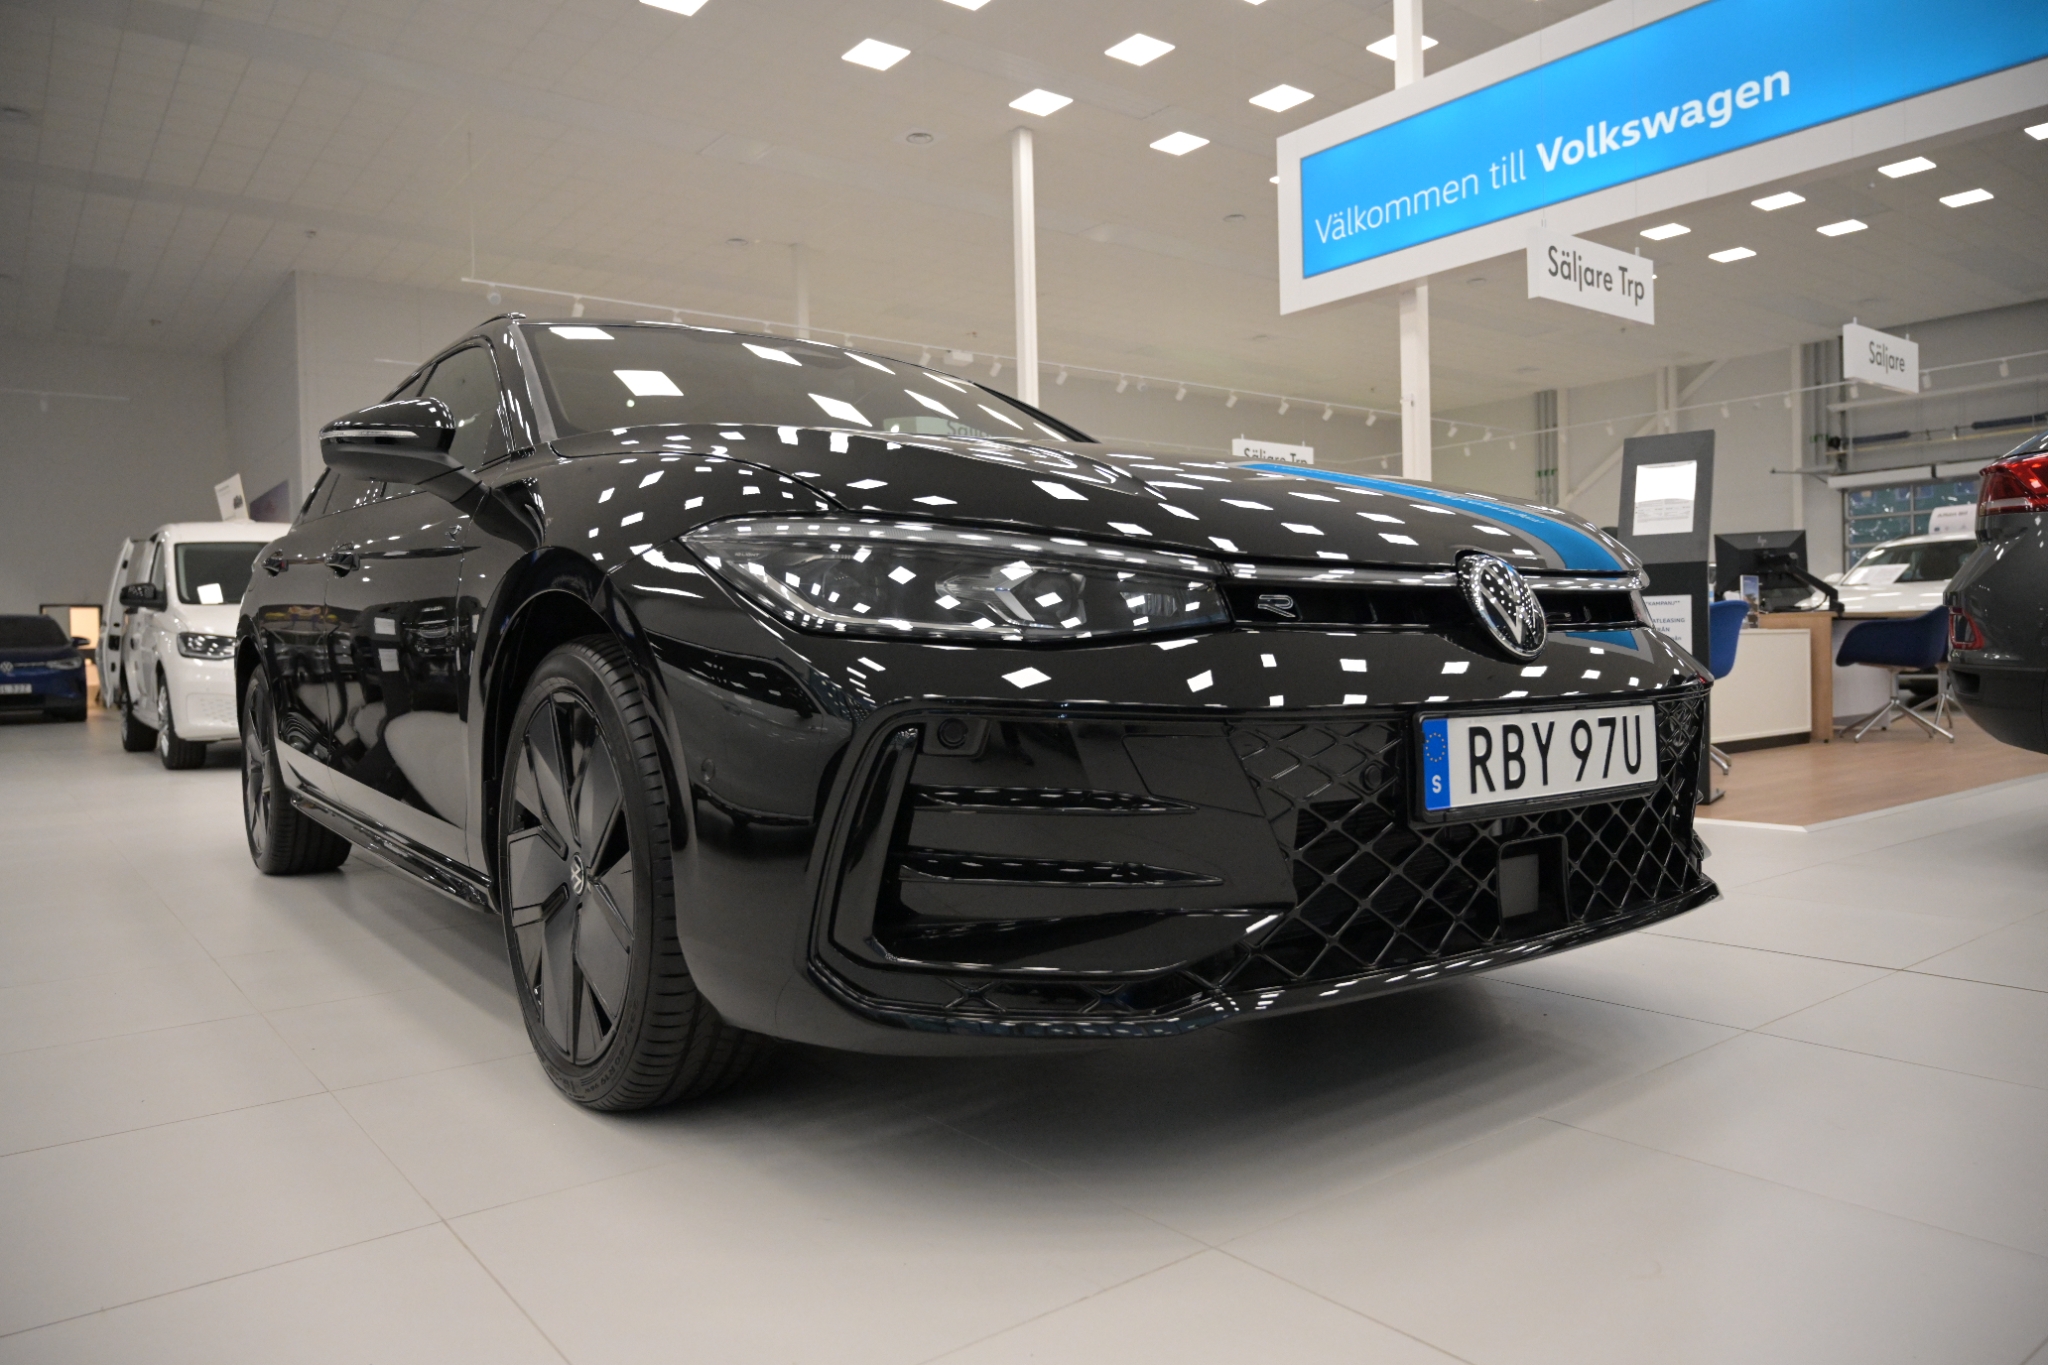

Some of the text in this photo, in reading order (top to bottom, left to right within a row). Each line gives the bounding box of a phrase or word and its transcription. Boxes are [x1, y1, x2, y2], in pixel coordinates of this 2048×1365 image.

[1315, 70, 1790, 243] Välkommen till Volkswagen
[1548, 245, 1645, 307] Säljare Trp
[1869, 341, 1905, 374] Säljare
[1432, 714, 1642, 794] S RBY 97U
